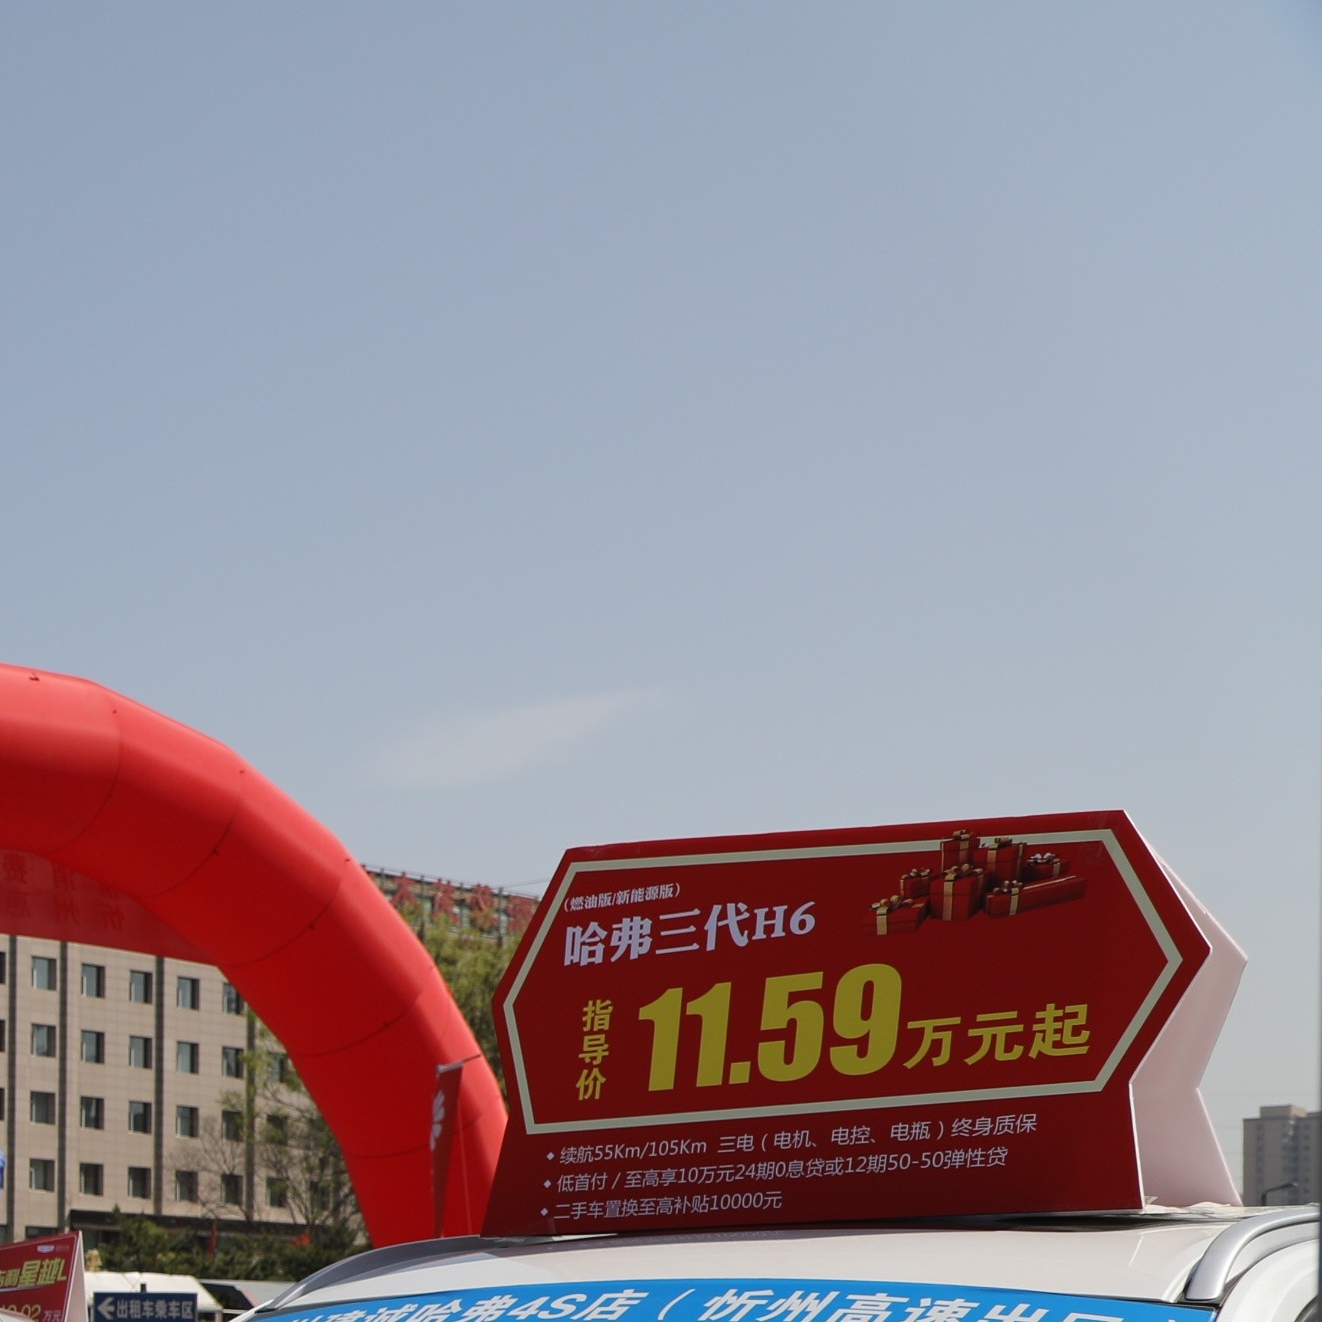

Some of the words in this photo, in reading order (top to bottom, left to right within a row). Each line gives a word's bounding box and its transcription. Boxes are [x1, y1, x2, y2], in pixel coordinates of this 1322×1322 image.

[563, 900, 817, 968] 哈弗三代H6
[577, 998, 613, 1101] 指导价
[638, 963, 1091, 1093] 11.59万元起
[560, 1138, 707, 1167] 续航55Km/105Km
[553, 1189, 783, 1221] 二手车置换至高补贴10000元
[116, 1297, 193, 1320] 出租车乘车区
